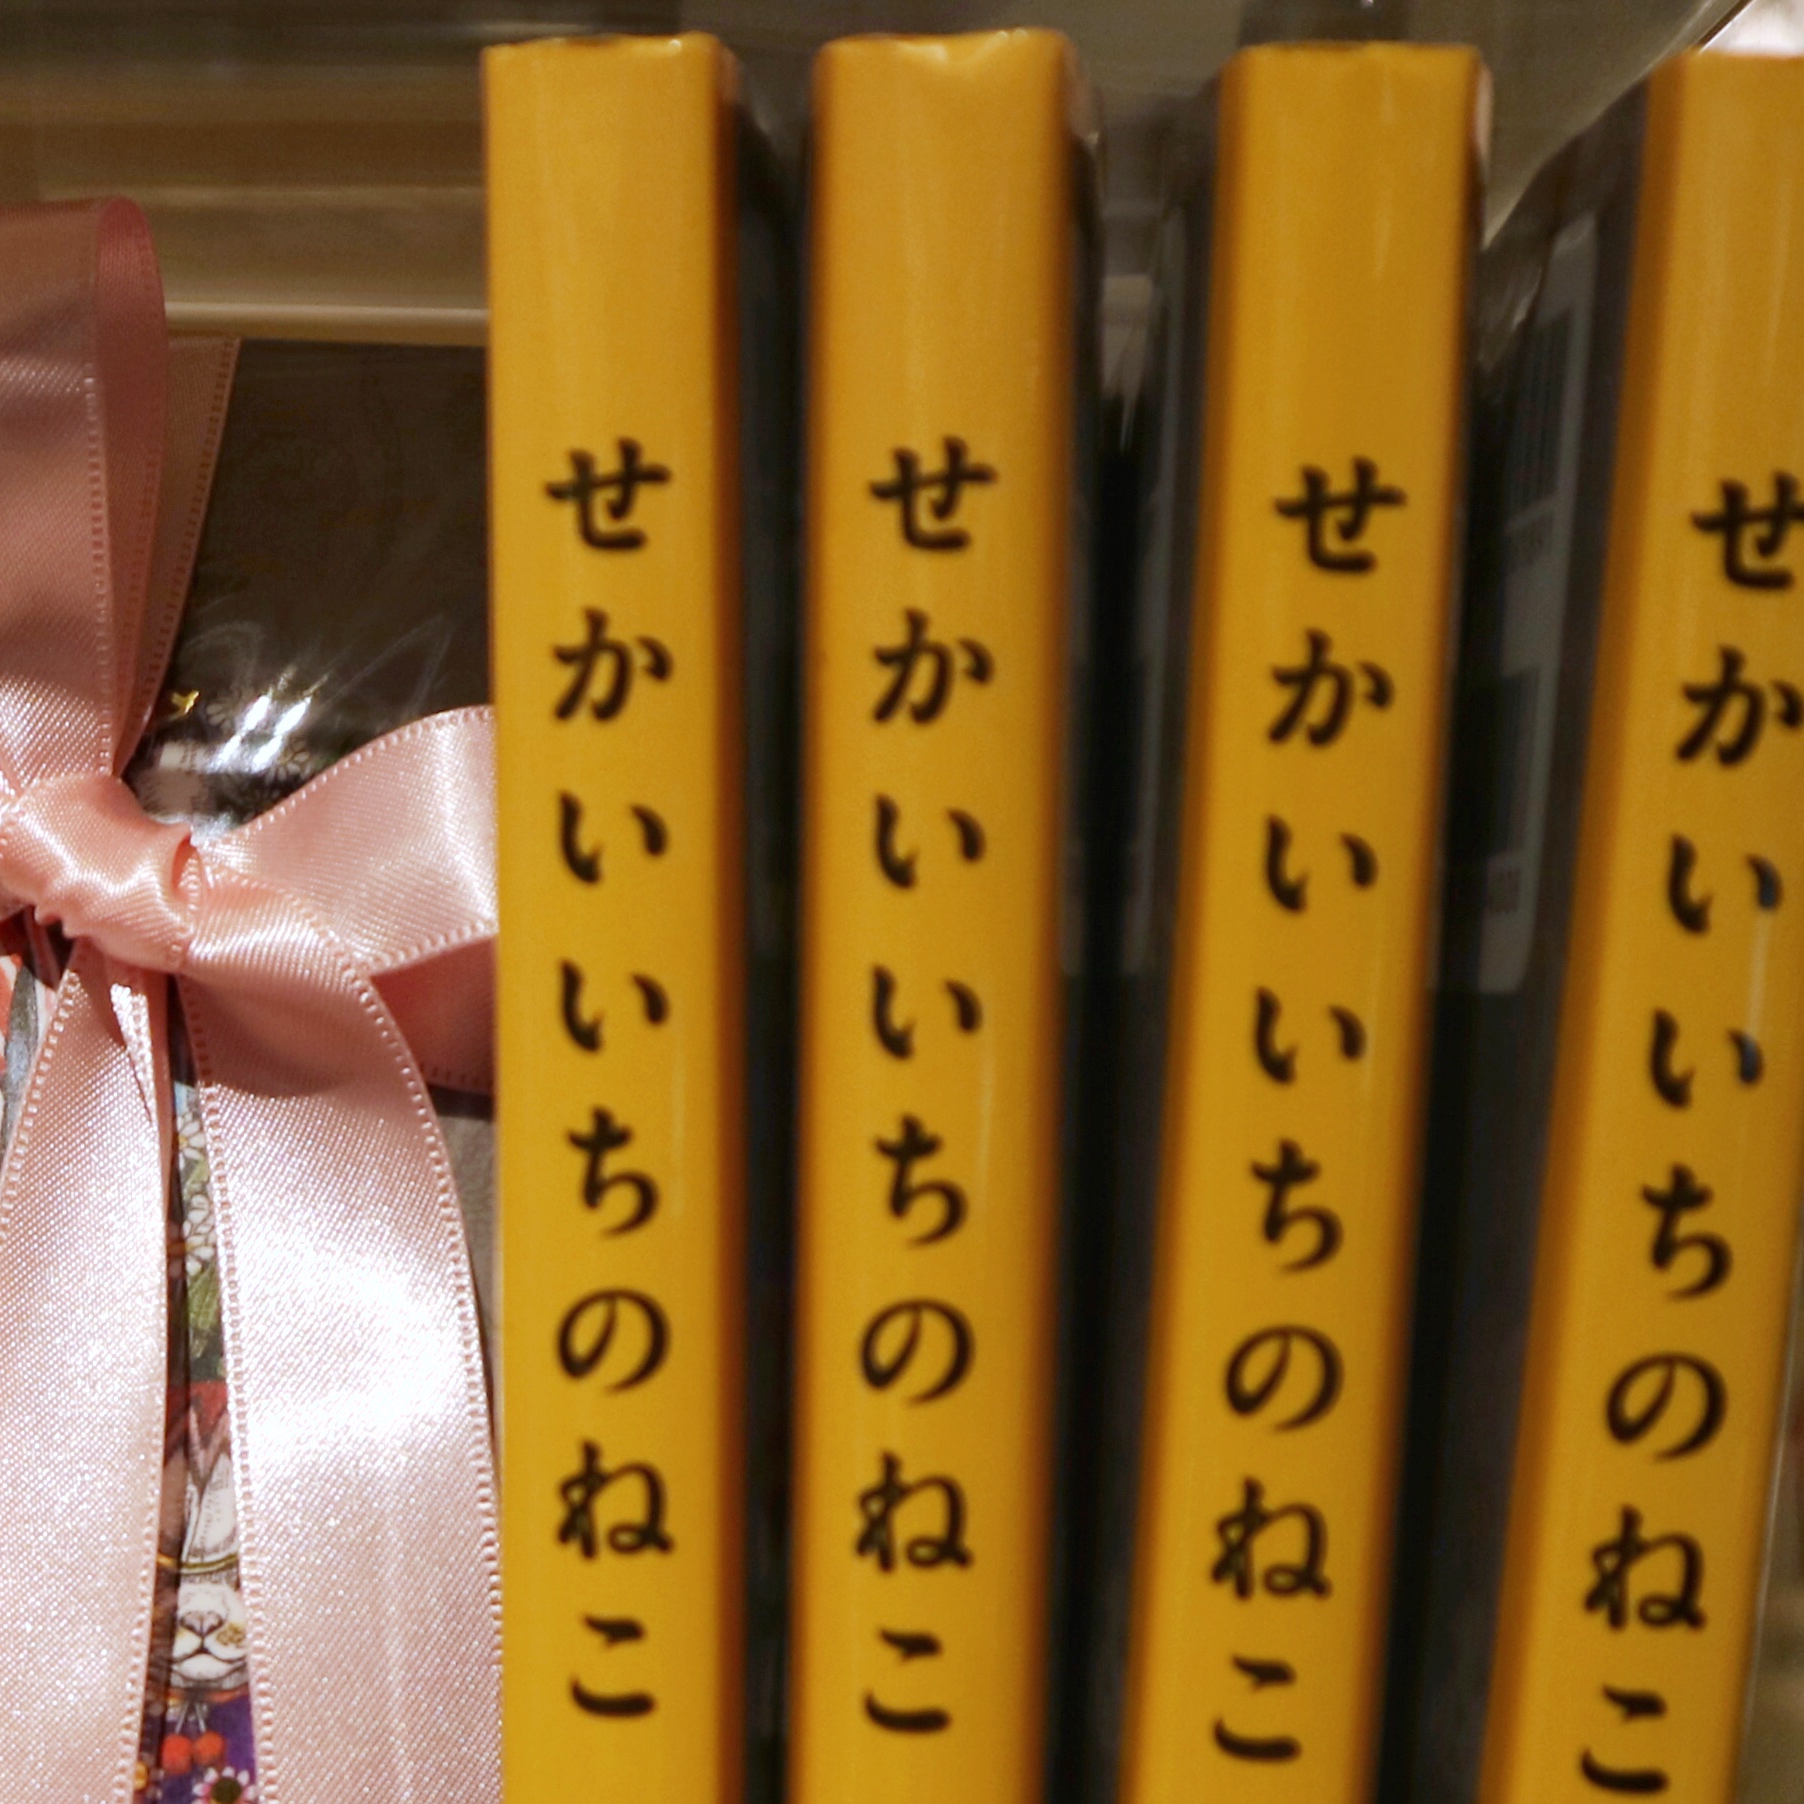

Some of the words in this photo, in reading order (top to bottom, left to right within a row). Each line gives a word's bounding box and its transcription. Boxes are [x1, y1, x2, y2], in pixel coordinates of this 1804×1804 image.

[544, 437, 672, 1718] せかいいちのねこ
[856, 436, 998, 1735] せかいいちのねこ
[1210, 455, 1407, 1764] せかいいちのねこ
[1580, 471, 1804, 1796] せかいいちのねこ
